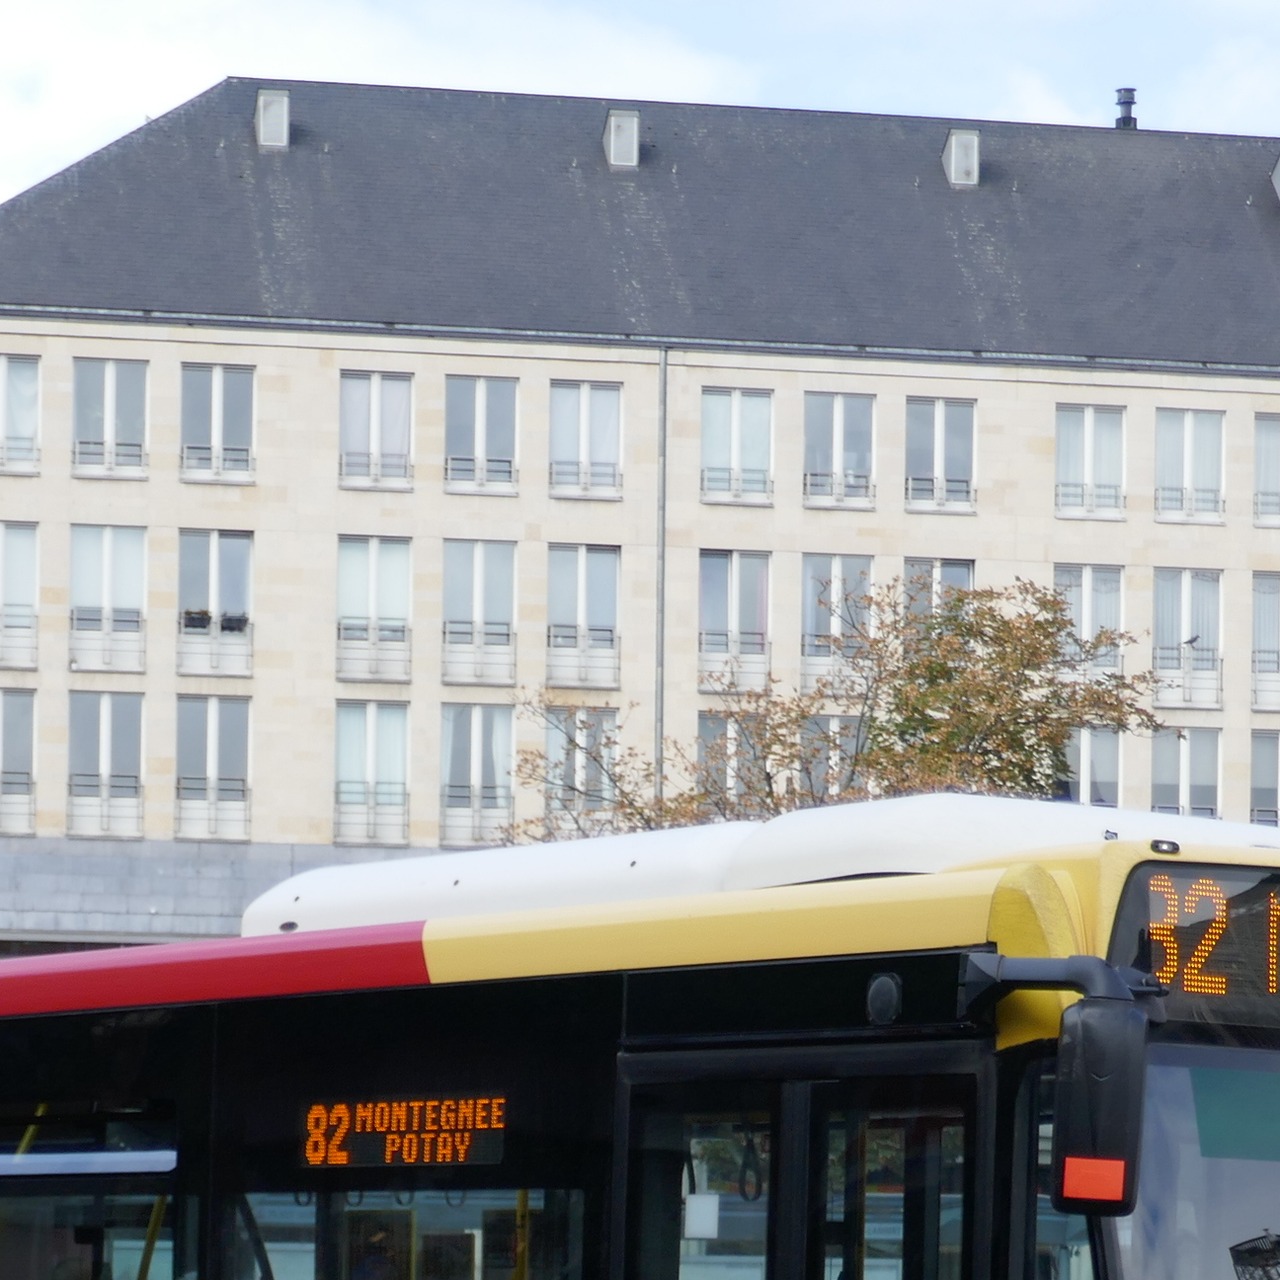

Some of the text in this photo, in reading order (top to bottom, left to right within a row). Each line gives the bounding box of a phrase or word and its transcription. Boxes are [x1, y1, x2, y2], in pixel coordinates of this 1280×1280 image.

[305, 1098, 506, 1165] 82 MONTEGNEE
[384, 1131, 471, 1164] POTAY
